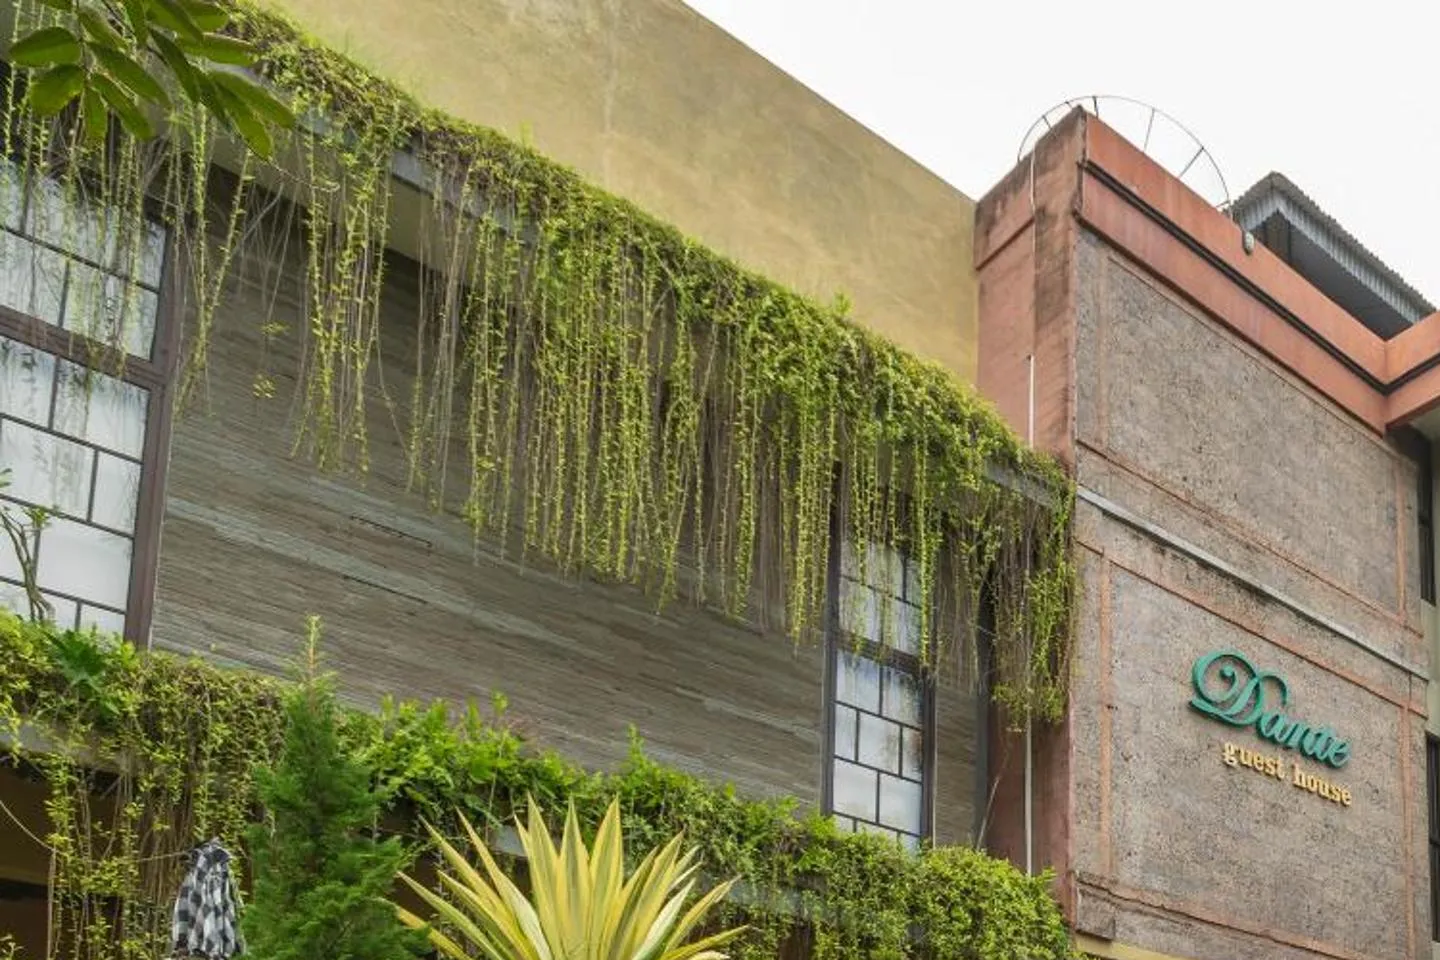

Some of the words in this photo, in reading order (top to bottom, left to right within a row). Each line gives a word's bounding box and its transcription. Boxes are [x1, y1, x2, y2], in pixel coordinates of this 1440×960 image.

[1188, 648, 1351, 769] Dante
[1223, 742, 1287, 780] guest
[1292, 763, 1352, 807] house
